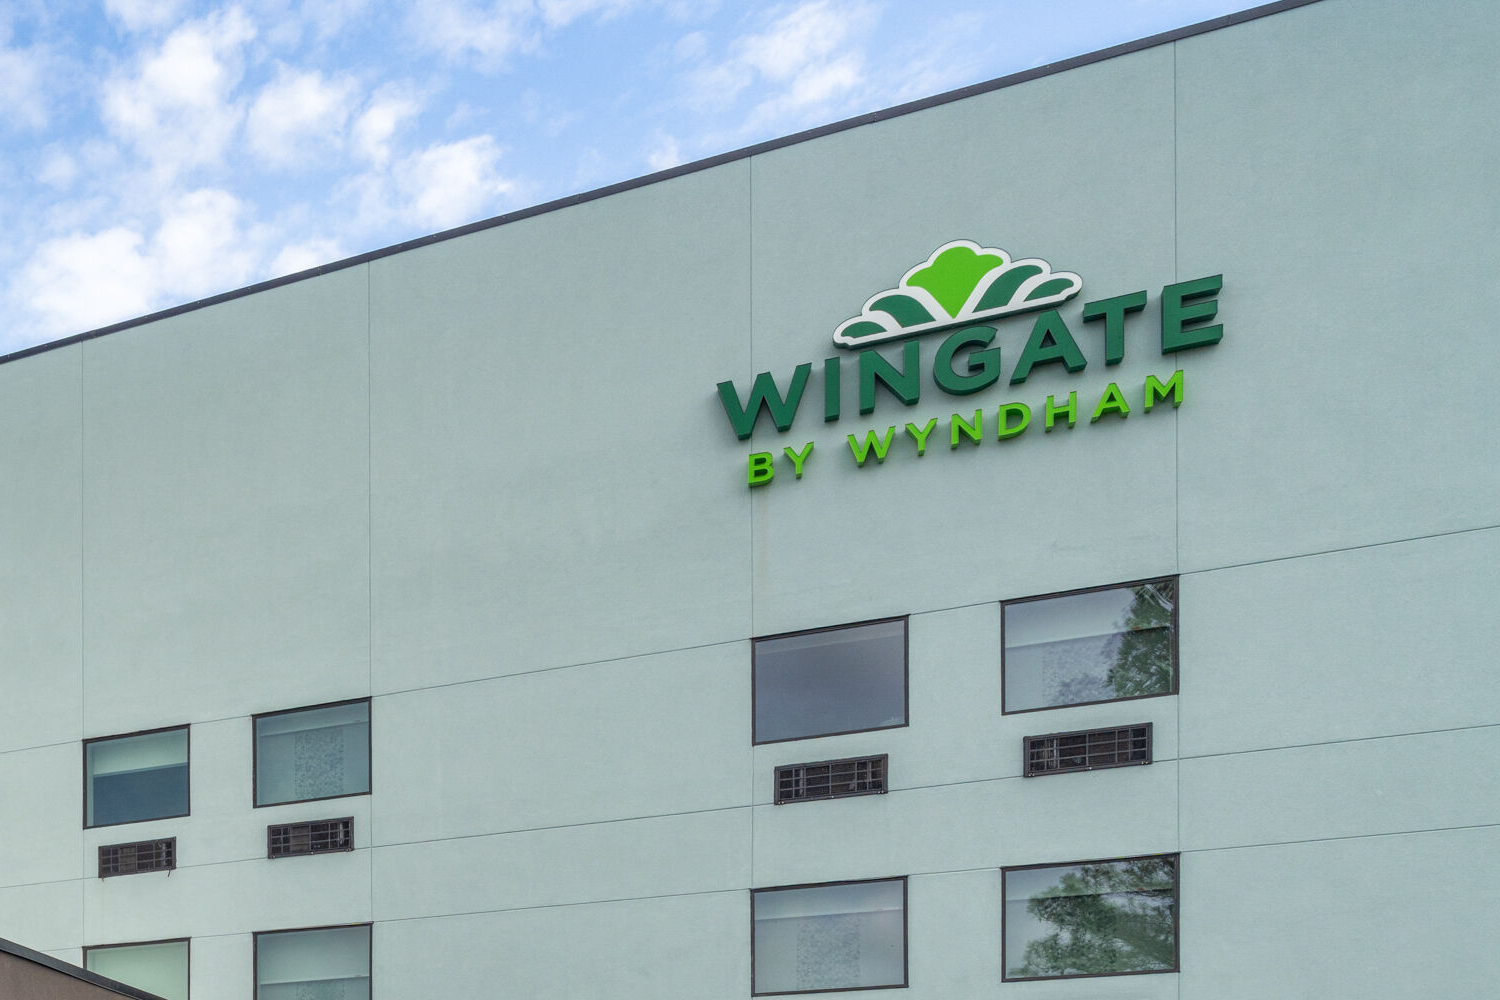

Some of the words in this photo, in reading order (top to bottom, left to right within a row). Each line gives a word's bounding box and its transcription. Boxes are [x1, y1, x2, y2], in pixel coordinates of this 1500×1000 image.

[716, 274, 1223, 441] WINGATE
[748, 441, 815, 488] BY
[847, 369, 1185, 468] WYNDHAM
